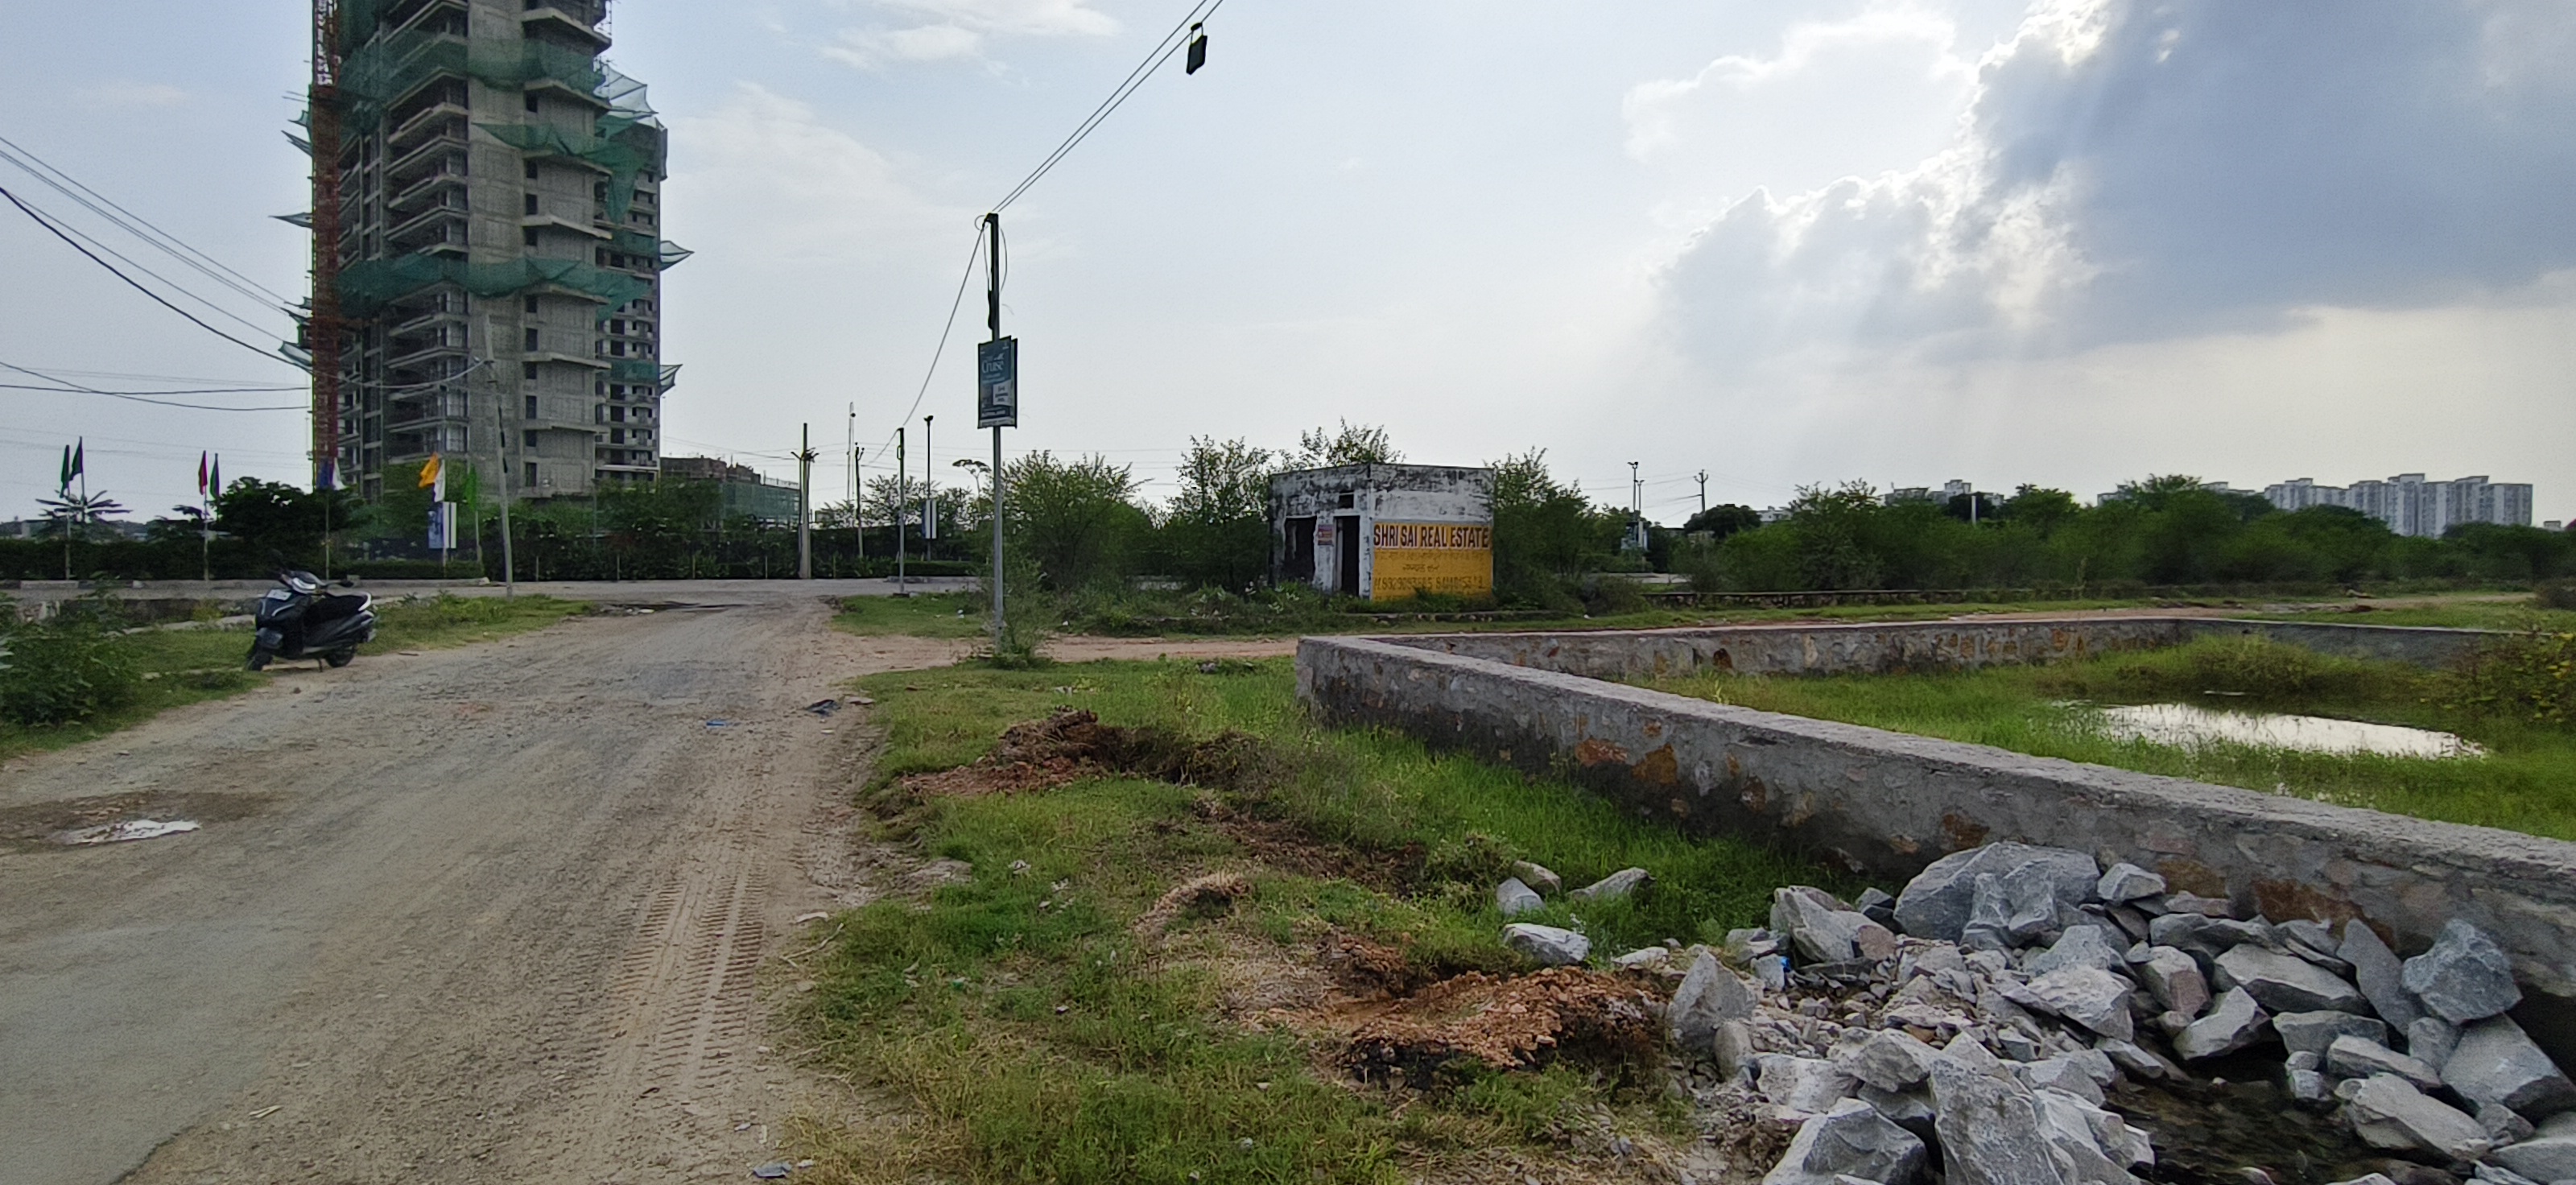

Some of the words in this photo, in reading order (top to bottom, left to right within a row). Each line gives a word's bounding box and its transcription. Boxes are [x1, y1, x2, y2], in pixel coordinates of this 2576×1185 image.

[1373, 524, 1398, 547] SHRI
[1400, 526, 1418, 547] SAI
[1420, 526, 1448, 548] REAL
[1450, 526, 1488, 548] ESTATE
